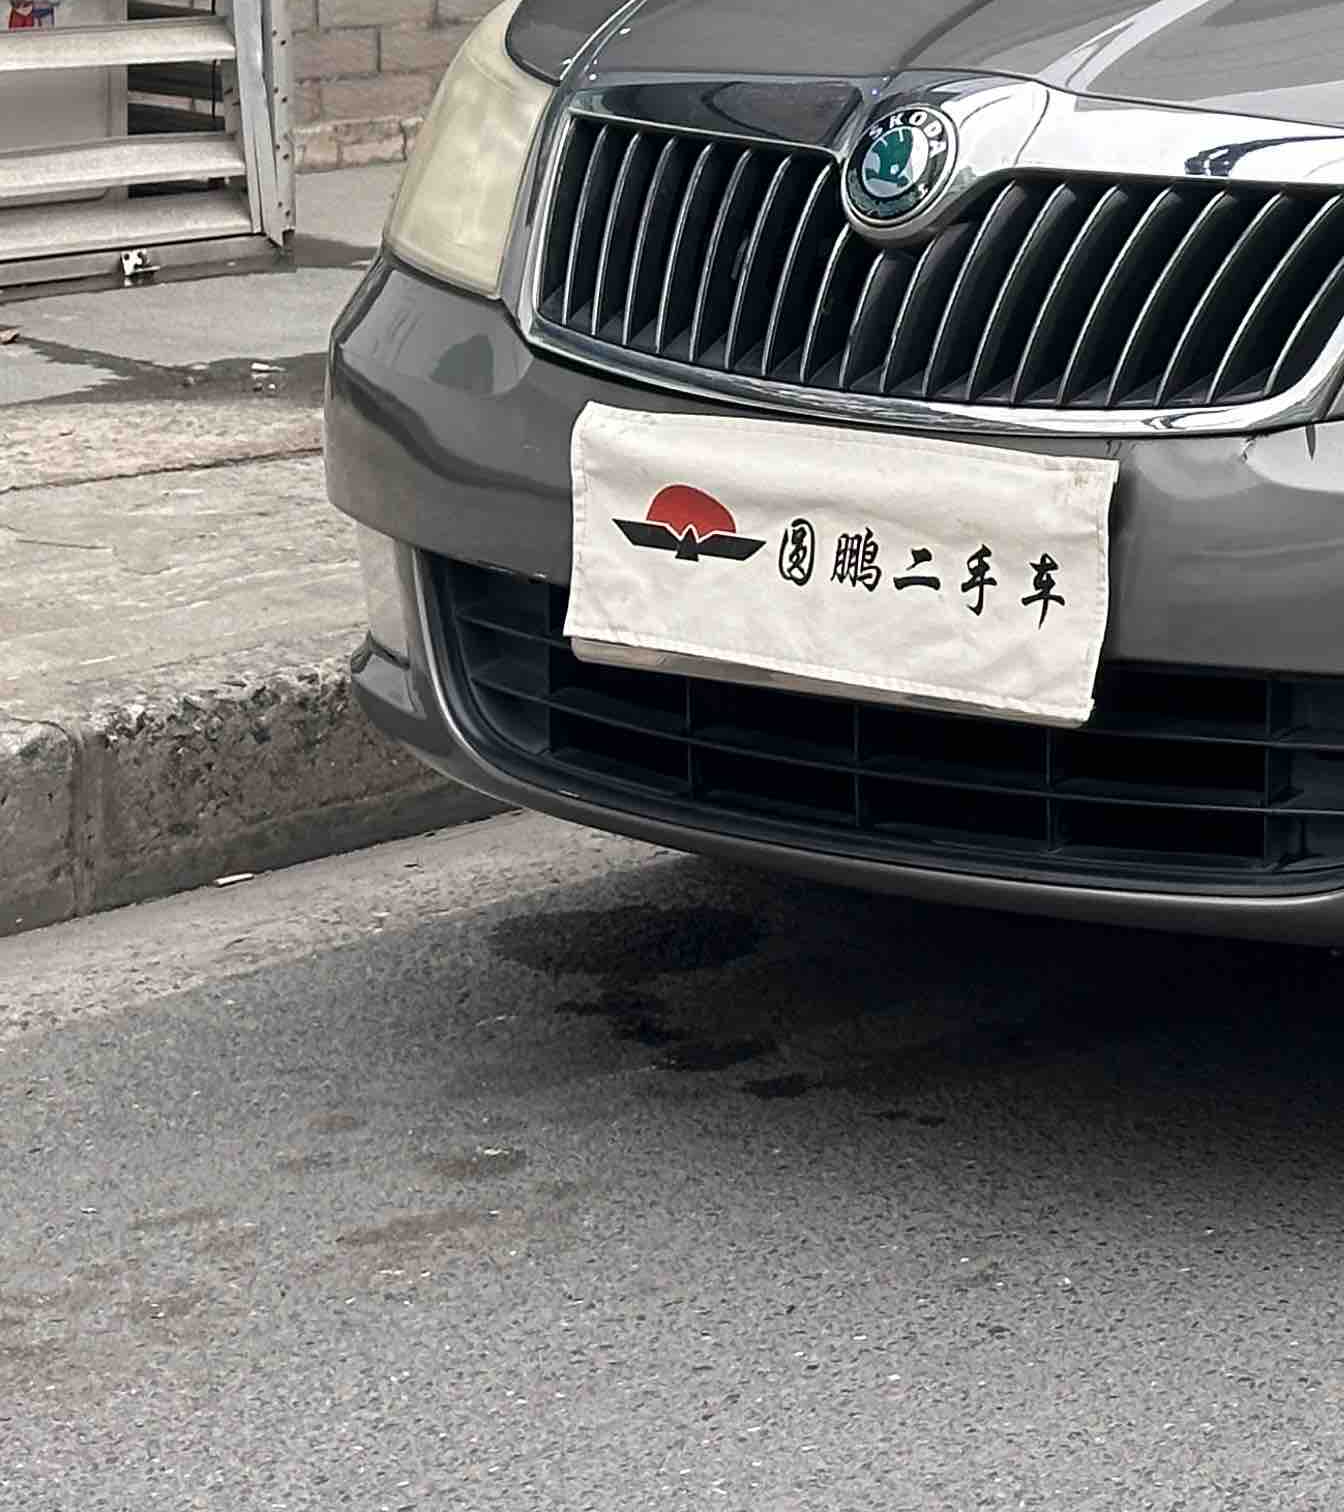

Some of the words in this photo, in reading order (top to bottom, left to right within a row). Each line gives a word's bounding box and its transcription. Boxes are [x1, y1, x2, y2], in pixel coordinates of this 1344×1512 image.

[778, 517, 1066, 628] 圆鹏二手车
